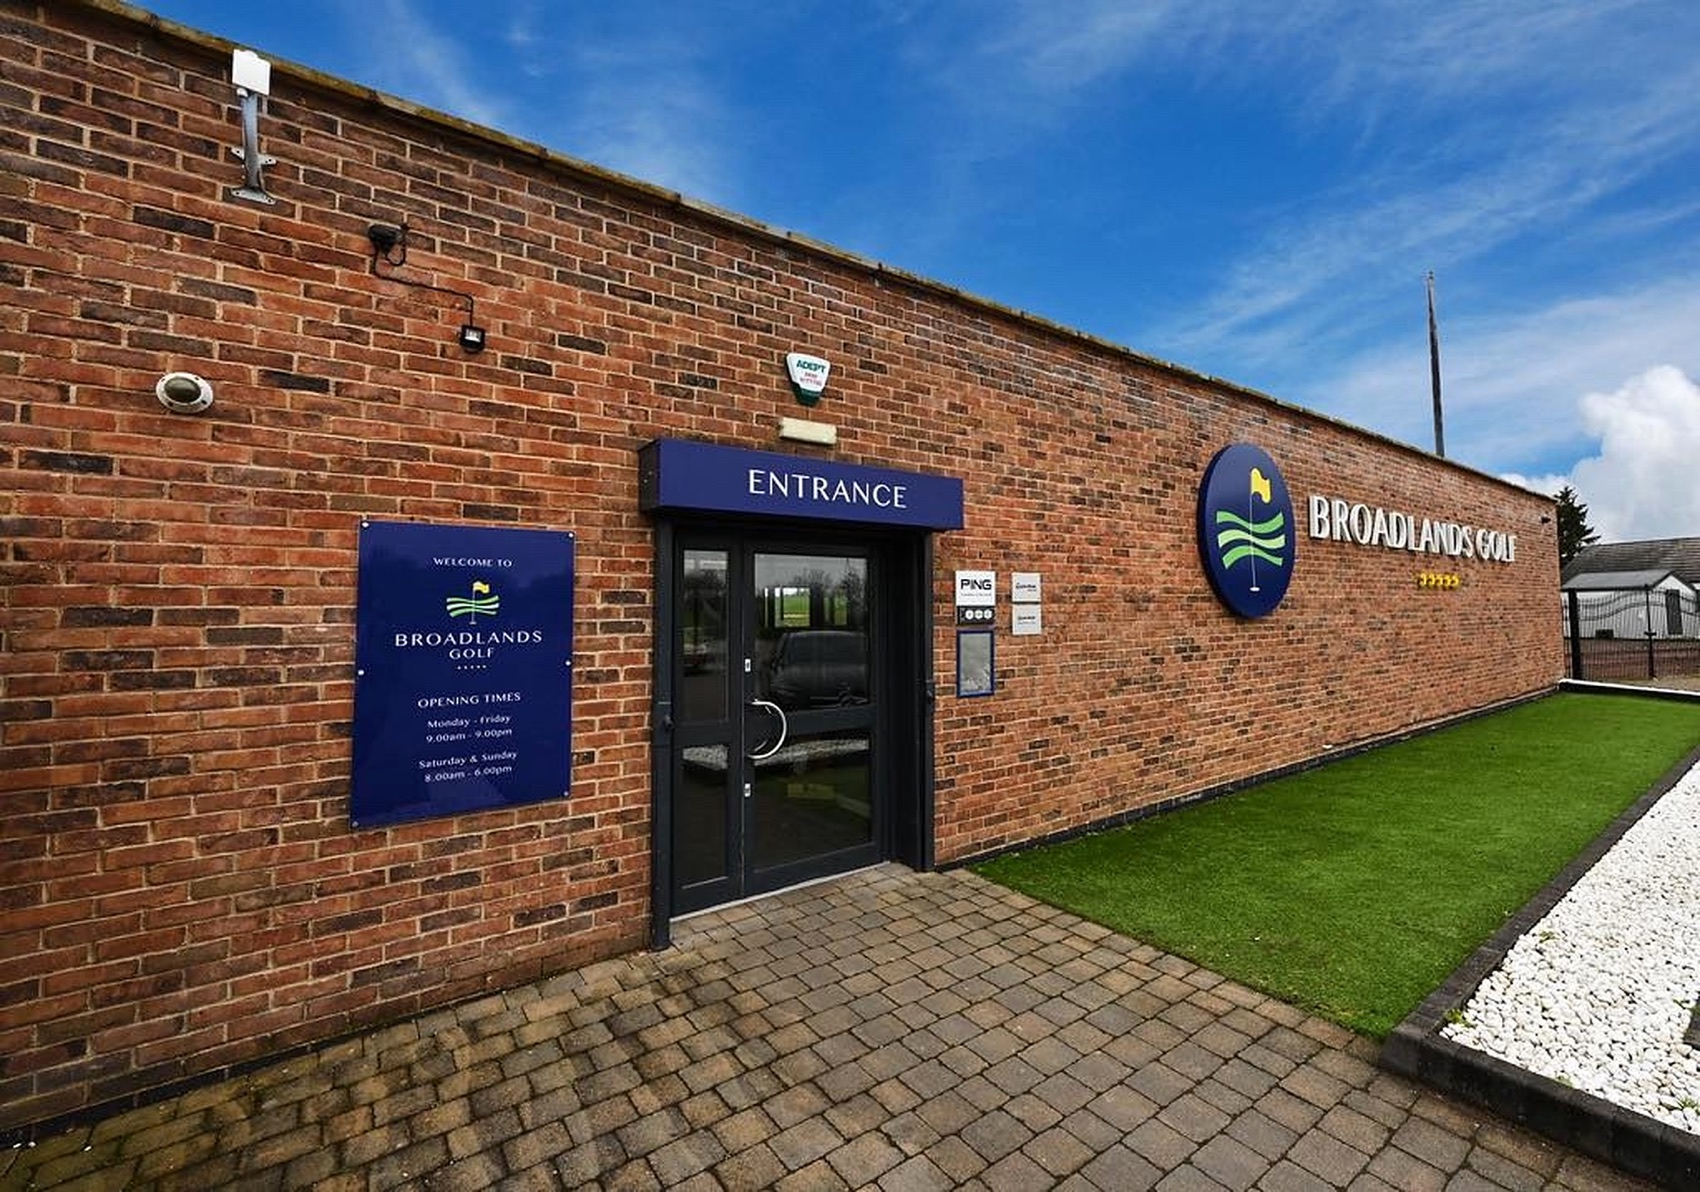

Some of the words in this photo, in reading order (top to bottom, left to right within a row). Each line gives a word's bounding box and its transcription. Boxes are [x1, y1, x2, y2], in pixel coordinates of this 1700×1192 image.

[796, 359, 827, 373] ADEPT
[749, 469, 908, 509] ENTRANCE
[1309, 496, 1473, 557] BROADLANDS
[1475, 528, 1518, 563] GOLF
[432, 557, 493, 567] WELCOME
[497, 559, 513, 568] TO
[960, 578, 993, 591] PING
[395, 630, 543, 647] BROADLANDS
[449, 647, 495, 660] GOLF
[418, 695, 479, 708] OPENING
[484, 692, 521, 703] TIMES
[427, 718, 470, 728] Monday
[480, 715, 511, 724] Friday
[426, 732, 466, 743] 9.00am
[475, 728, 513, 739] 9.00pm
[419, 757, 466, 769] Saturday
[469, 755, 478, 764] &
[481, 751, 517, 761] Sunday
[424, 771, 466, 783] 8.00am
[474, 765, 513, 777] 6.00pm
